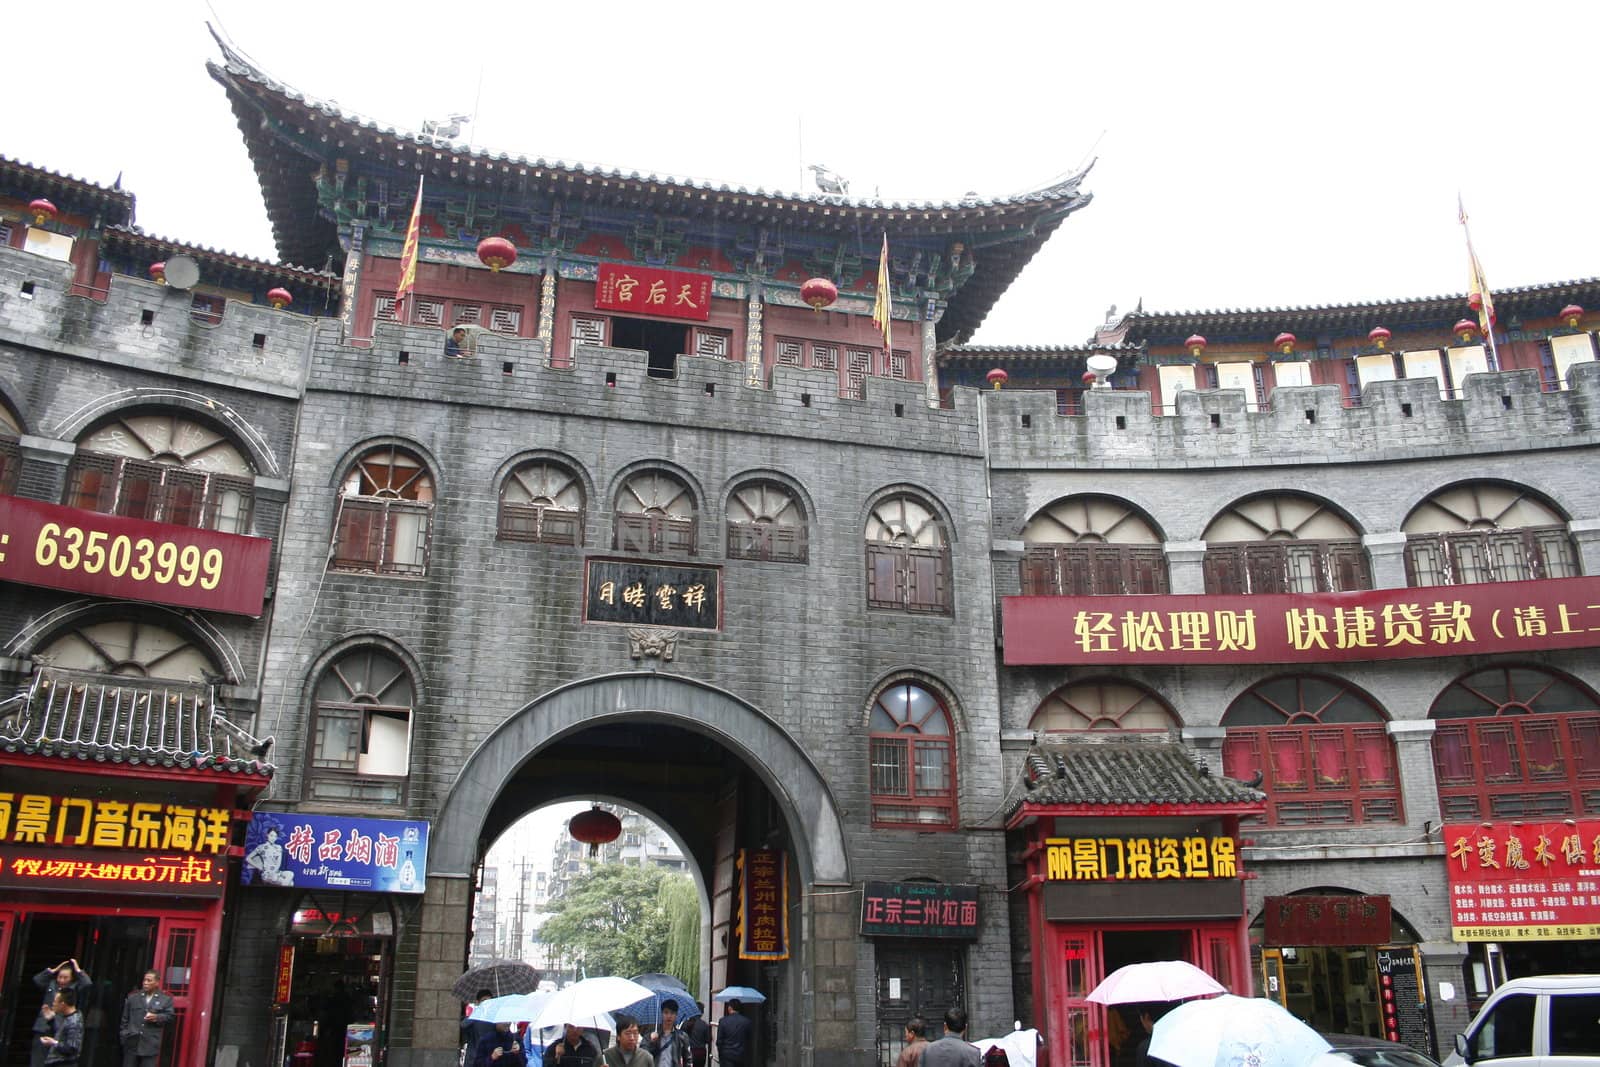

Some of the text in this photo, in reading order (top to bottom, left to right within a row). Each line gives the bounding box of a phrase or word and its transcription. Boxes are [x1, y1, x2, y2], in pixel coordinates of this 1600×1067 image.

[615, 274, 698, 309] 天后宫
[35, 522, 223, 590] 63503999
[1073, 609, 1256, 652] 轻松理财
[1285, 600, 1476, 650] 快捷贷款
[285, 824, 400, 869] 精品烟酒
[1045, 836, 1237, 880] 丽景门投资担保
[865, 896, 977, 926] 正宗兰州拉面
